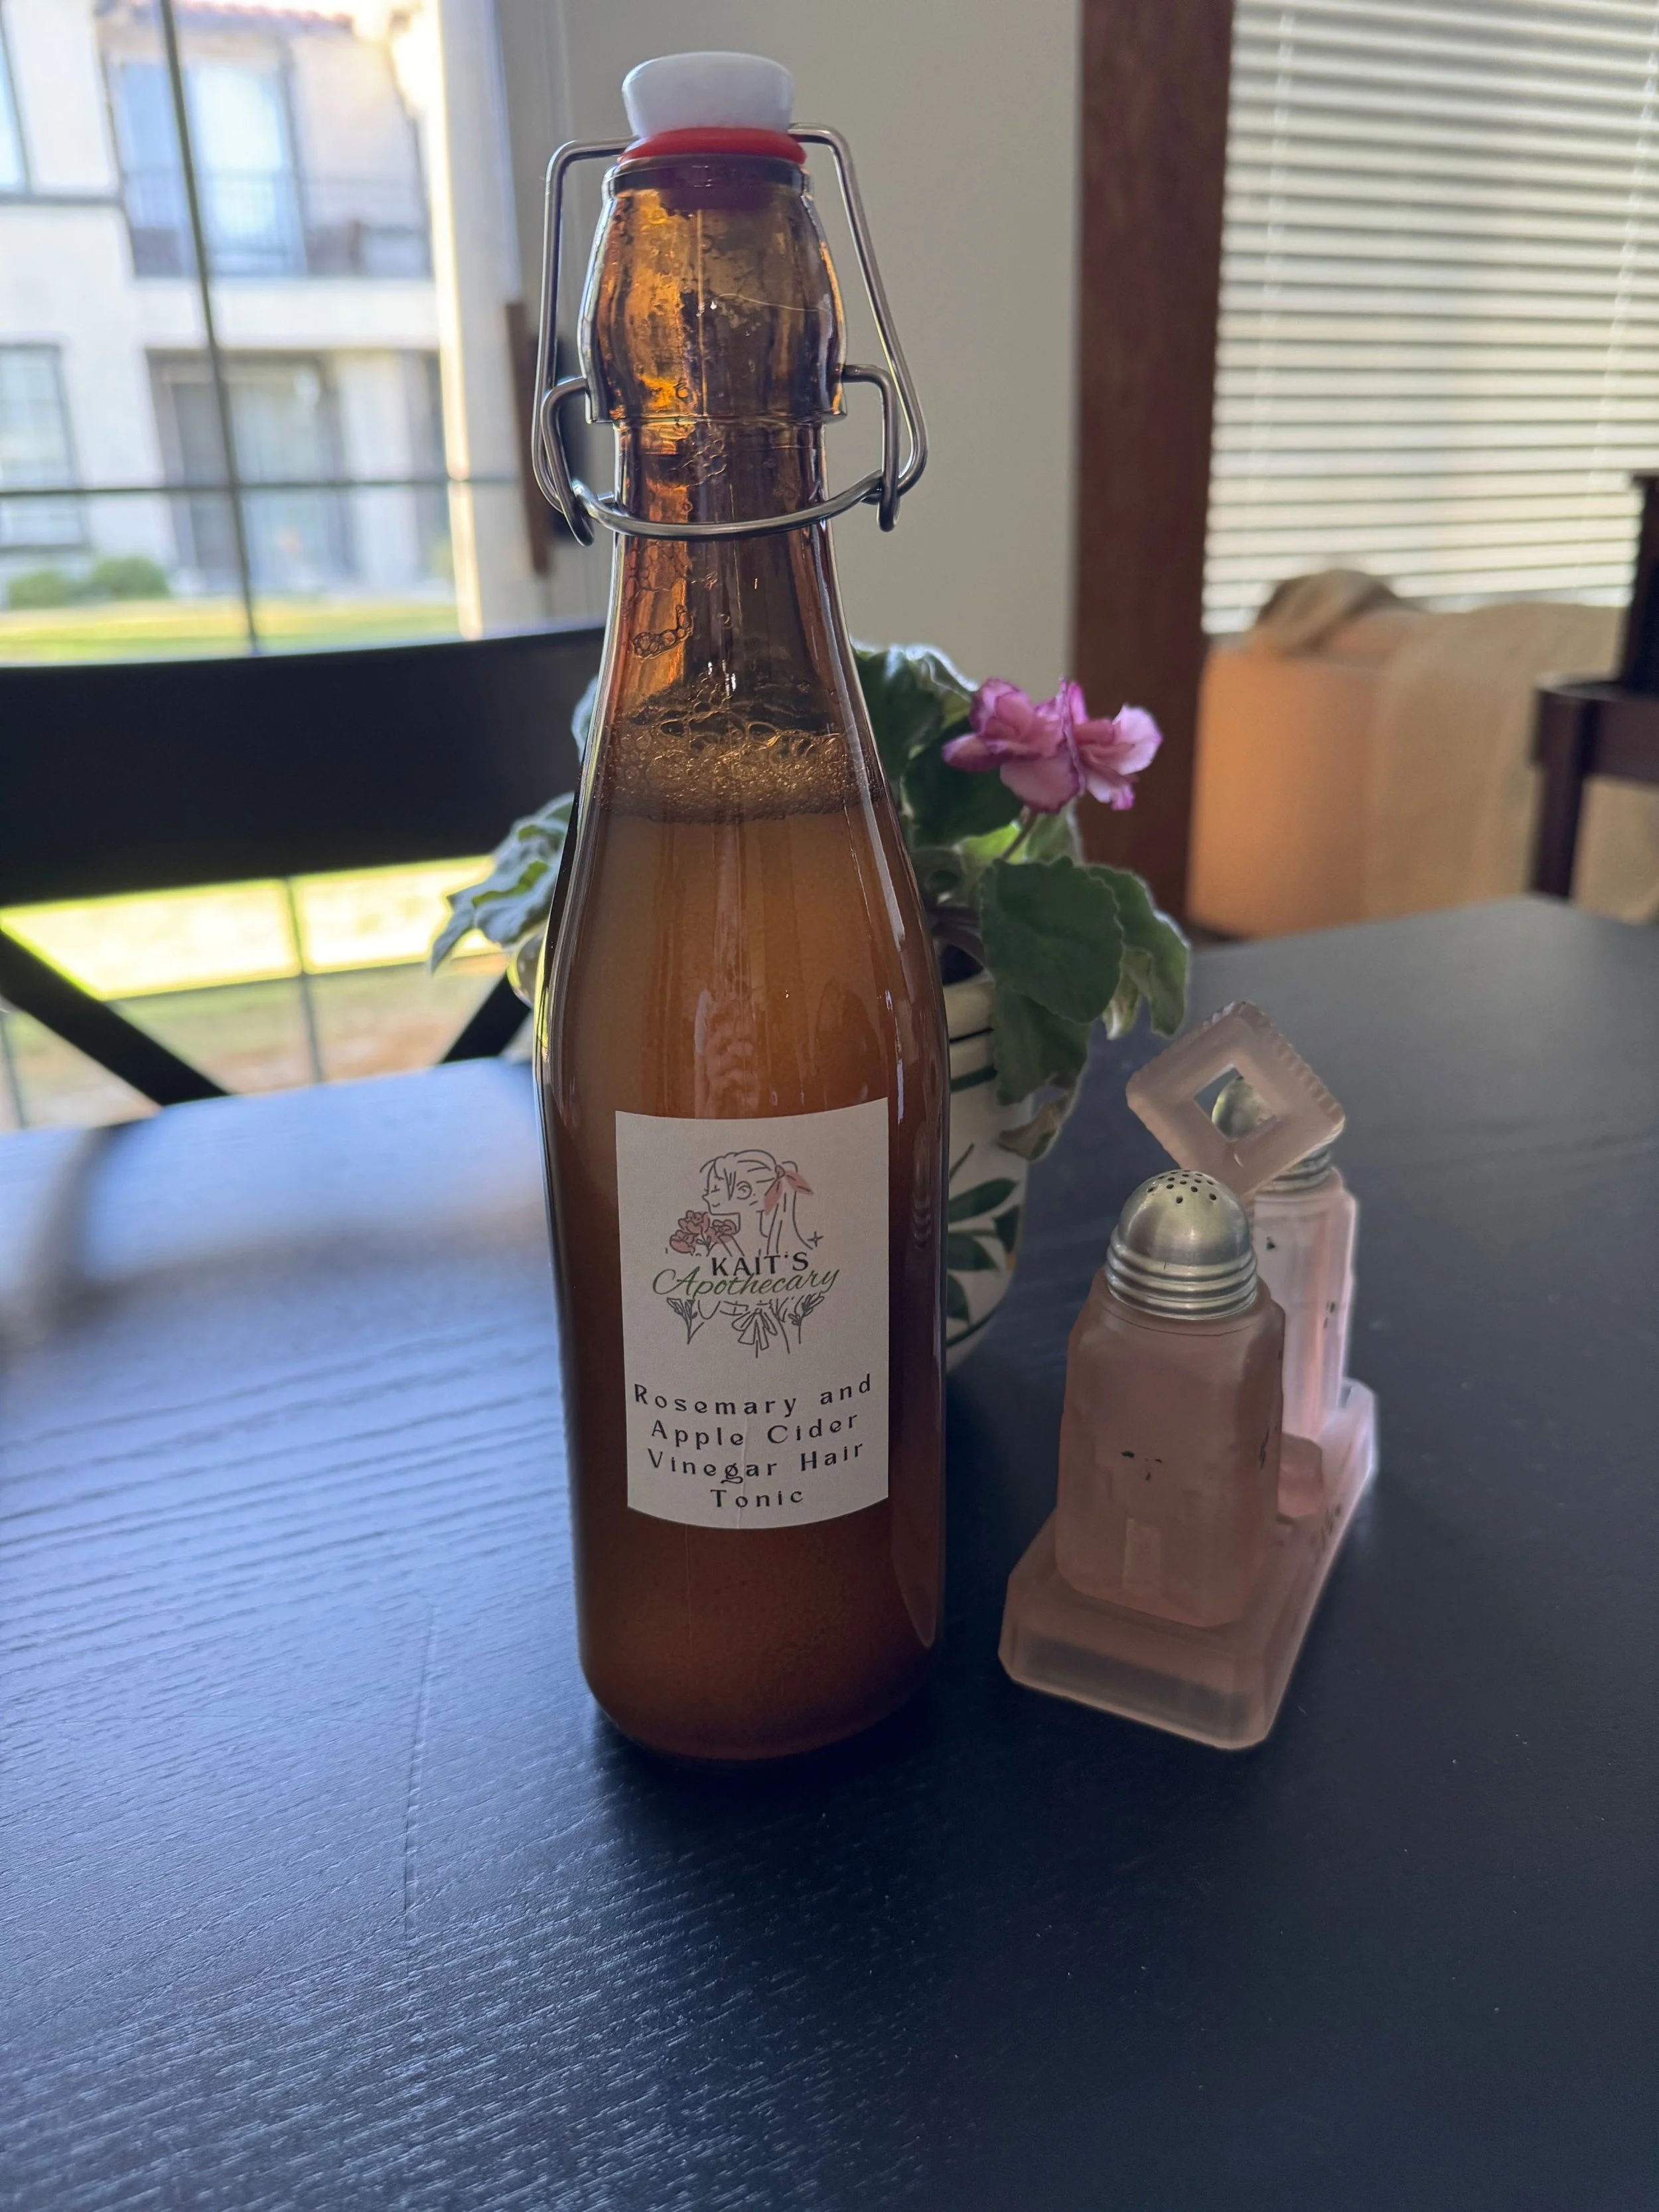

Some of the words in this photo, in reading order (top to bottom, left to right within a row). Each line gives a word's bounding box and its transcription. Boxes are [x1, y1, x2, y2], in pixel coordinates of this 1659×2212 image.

[711, 1251, 809, 1277] KAIT'S
[652, 1266, 840, 1297] Apothecary
[634, 1384, 797, 1417] Rosemary
[820, 1374, 872, 1406] and
[652, 1421, 745, 1451] Apple
[768, 1414, 858, 1444] Cider
[648, 1448, 778, 1484] Vinegar
[800, 1443, 863, 1472] Hair
[711, 1489, 804, 1509] Tonic
